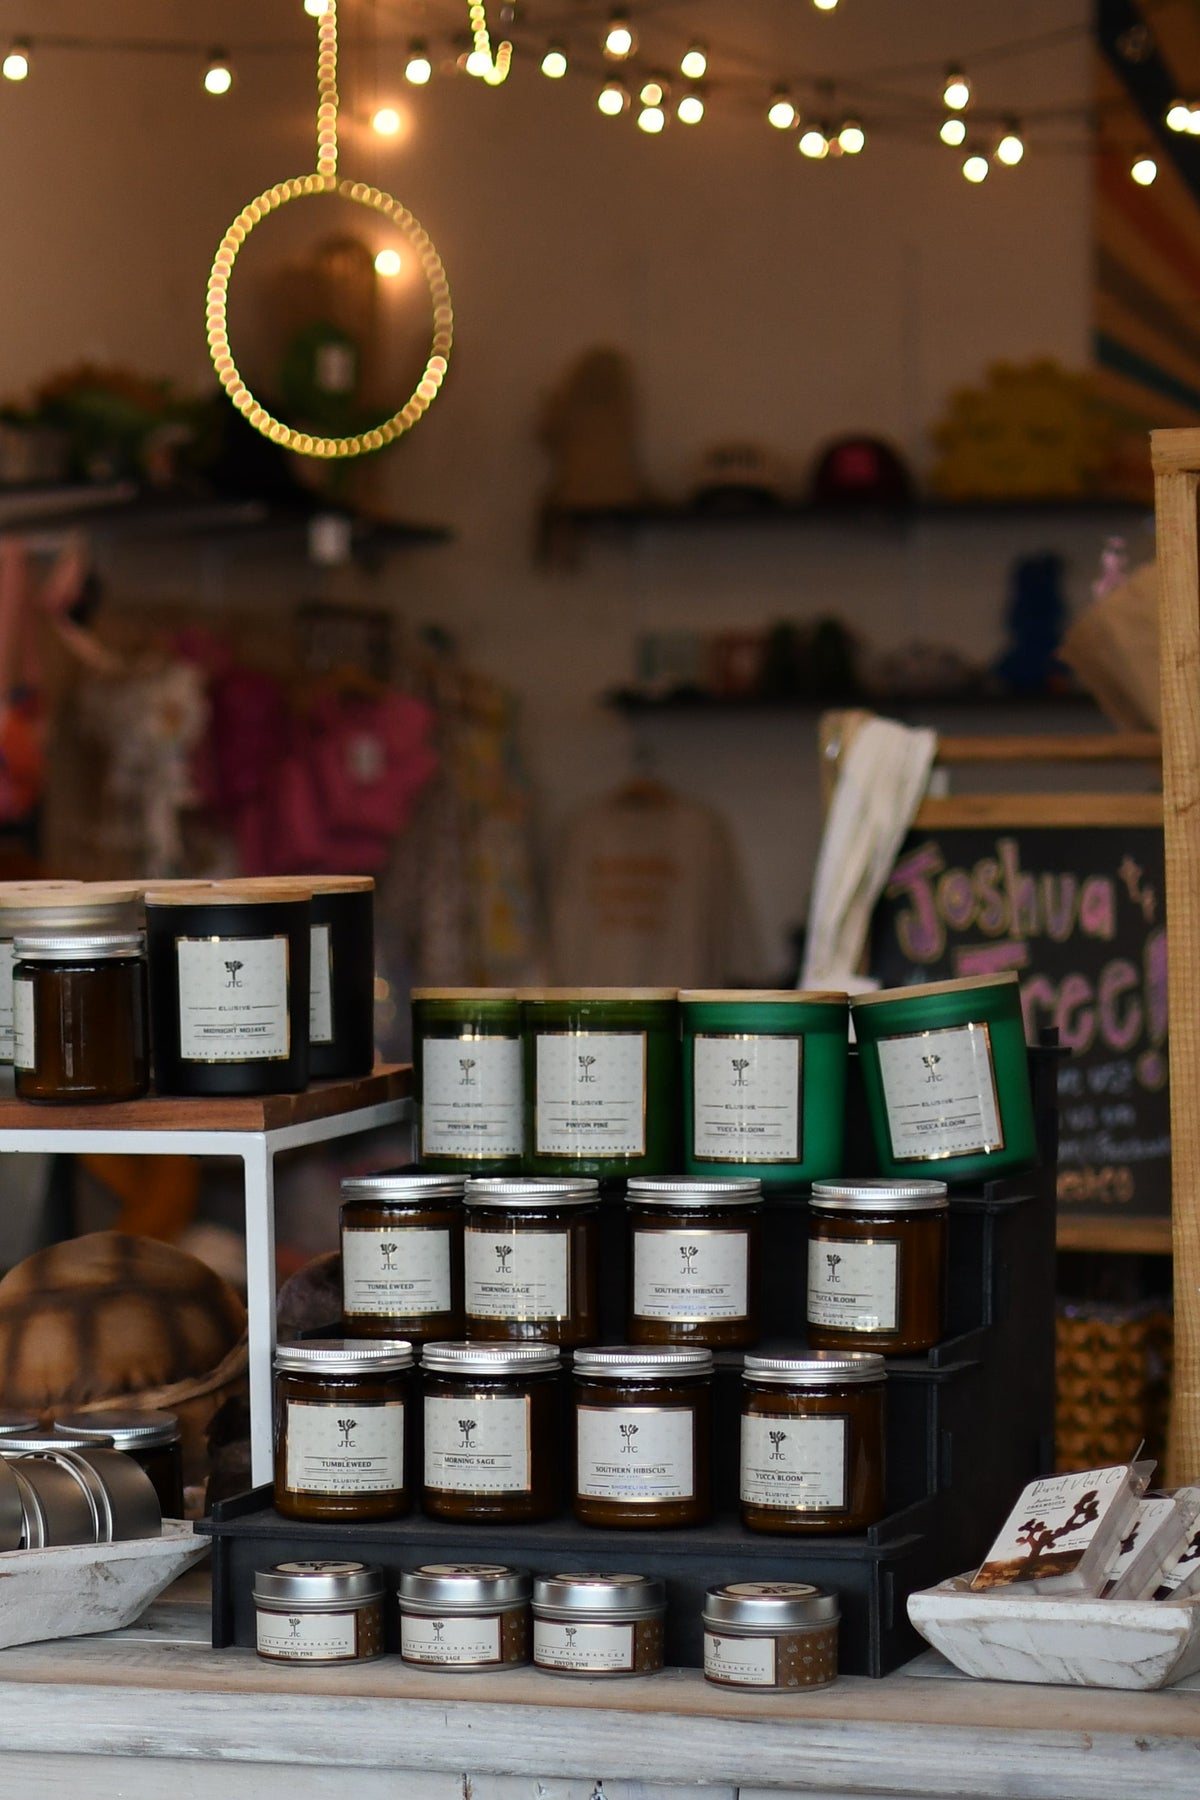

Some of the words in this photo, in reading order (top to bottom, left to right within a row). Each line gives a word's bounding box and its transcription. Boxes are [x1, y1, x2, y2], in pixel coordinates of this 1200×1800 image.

[889, 838, 1116, 964] Joshua
[225, 980, 243, 988] JTC
[203, 1026, 237, 1034] MIDNIGHT
[460, 1078, 476, 1086] JTC
[926, 1074, 943, 1083] JTC
[922, 1098, 954, 1108] ELUSIVE
[940, 1119, 966, 1128] BLOOM
[496, 1266, 512, 1274] JTC
[826, 1275, 840, 1283] JTC
[481, 1286, 510, 1294] MORNING
[816, 1294, 832, 1302] YUCCA
[338, 1440, 356, 1448] JTC
[458, 1440, 476, 1448] JTC
[444, 1456, 474, 1464] MORNING
[769, 1452, 786, 1460] JTC
